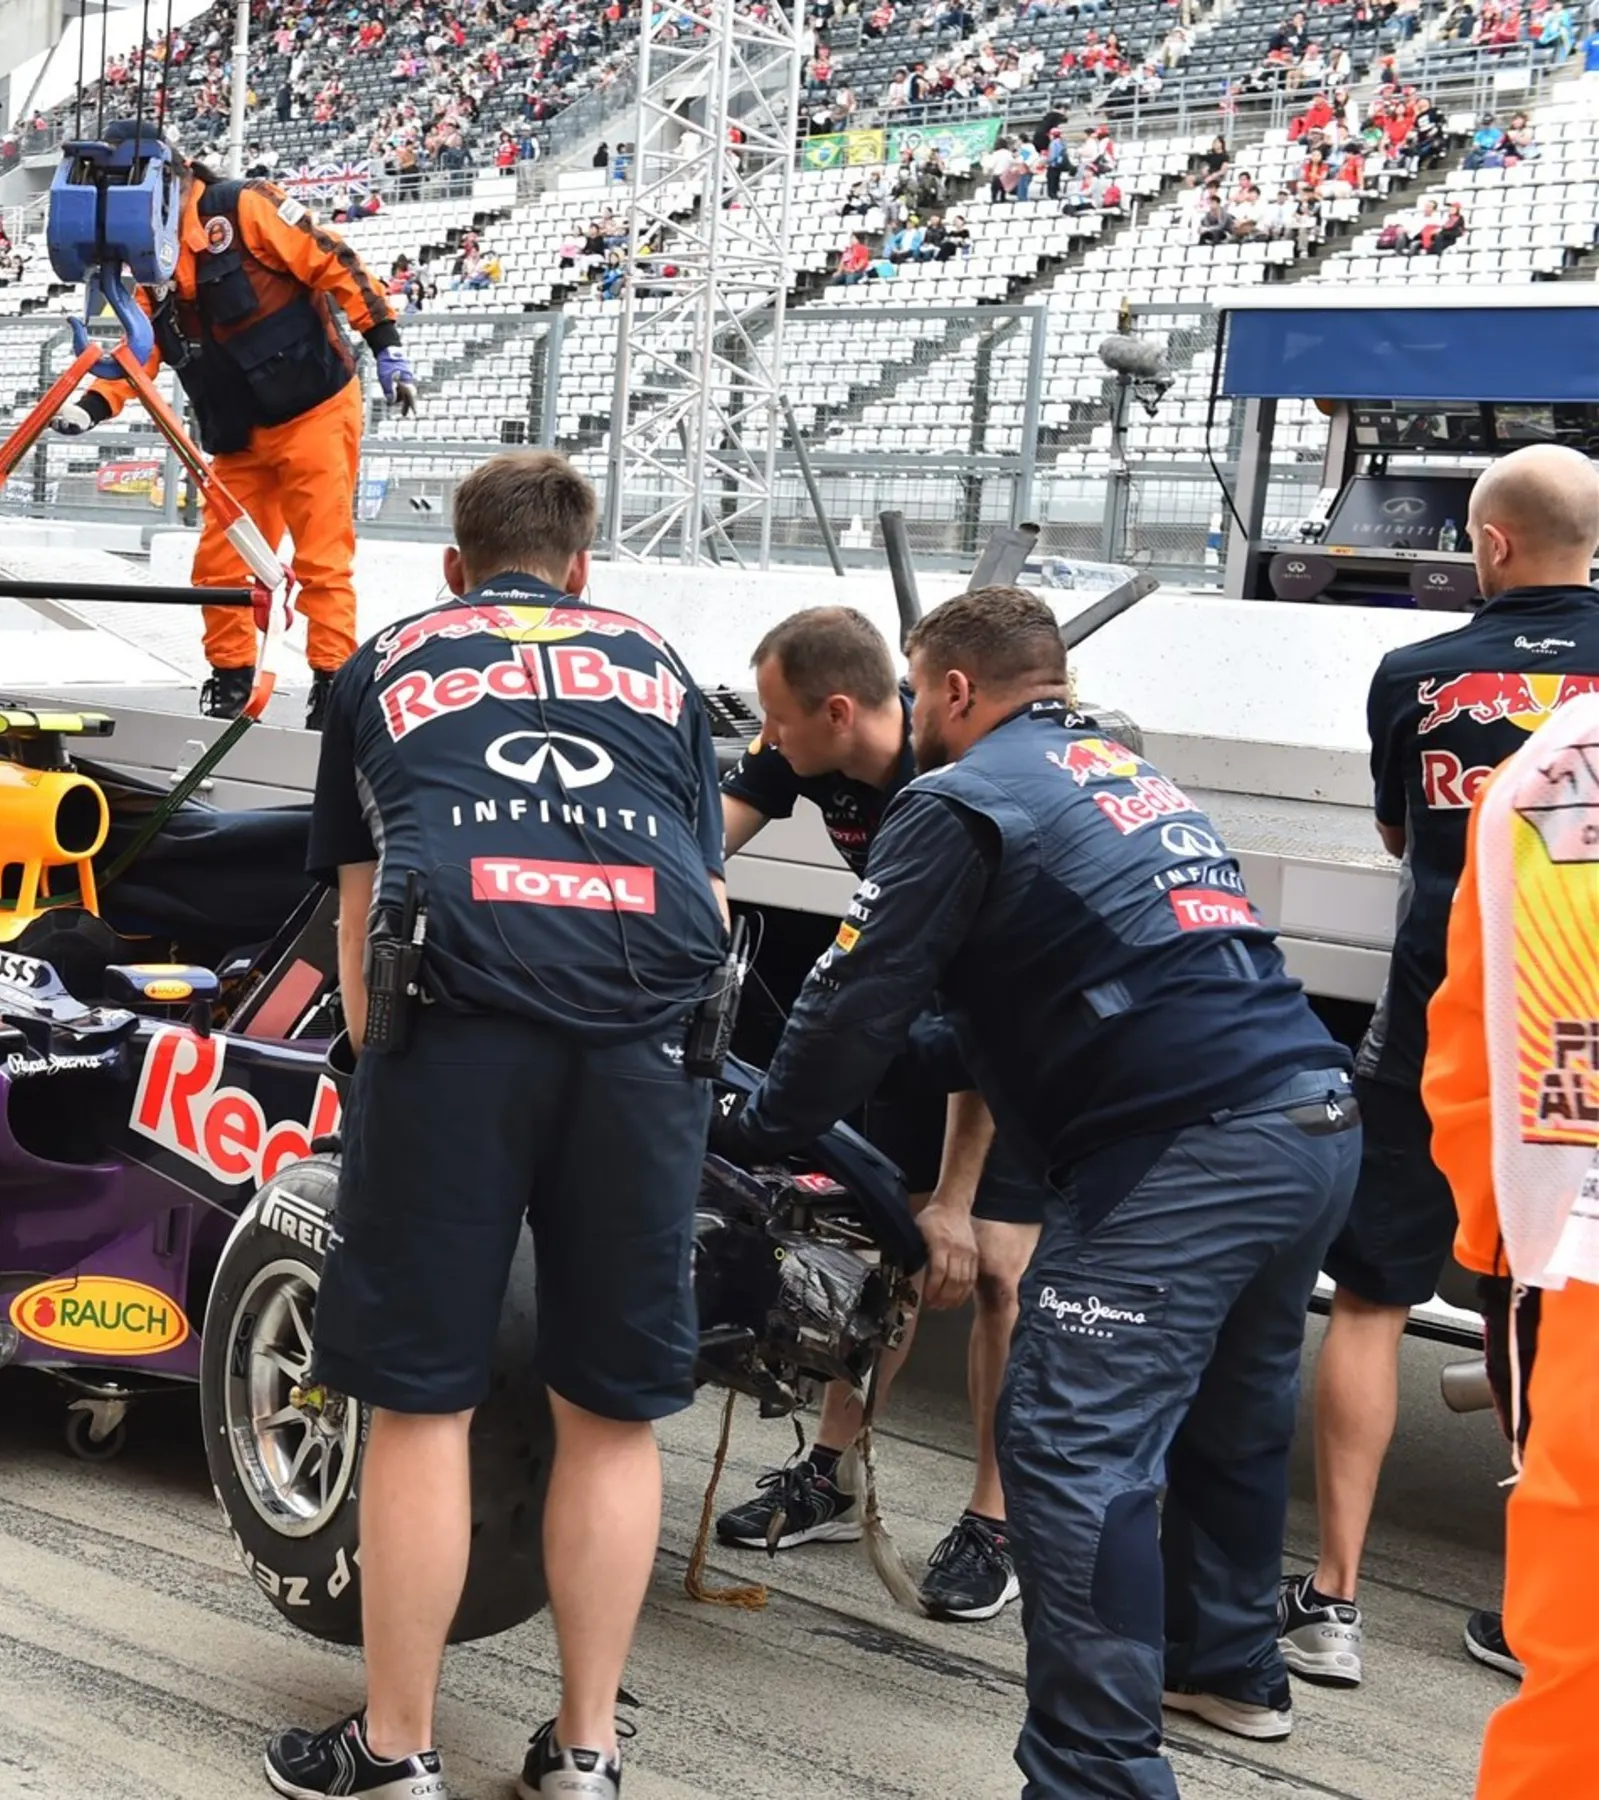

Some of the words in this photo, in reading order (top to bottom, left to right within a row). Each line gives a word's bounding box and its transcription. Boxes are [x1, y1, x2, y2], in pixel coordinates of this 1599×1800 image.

[1353, 522, 1436, 537] INFINITI
[377, 642, 548, 744] Red
[548, 644, 688, 728] Bull
[1420, 749, 1498, 810] Re
[452, 799, 658, 838] INFINITI
[1092, 776, 1170, 836] Red
[483, 863, 645, 904] TOTAL
[7, 1052, 49, 1076] Pepe
[48, 1054, 103, 1074] Jeans
[128, 1026, 343, 1190] Red
[259, 1185, 340, 1257] PIREL
[59, 1299, 168, 1337] RAUCH
[1038, 1286, 1084, 1320] Pepe
[1082, 1296, 1148, 1324] Jeans
[1061, 1323, 1114, 1339] LONDON
